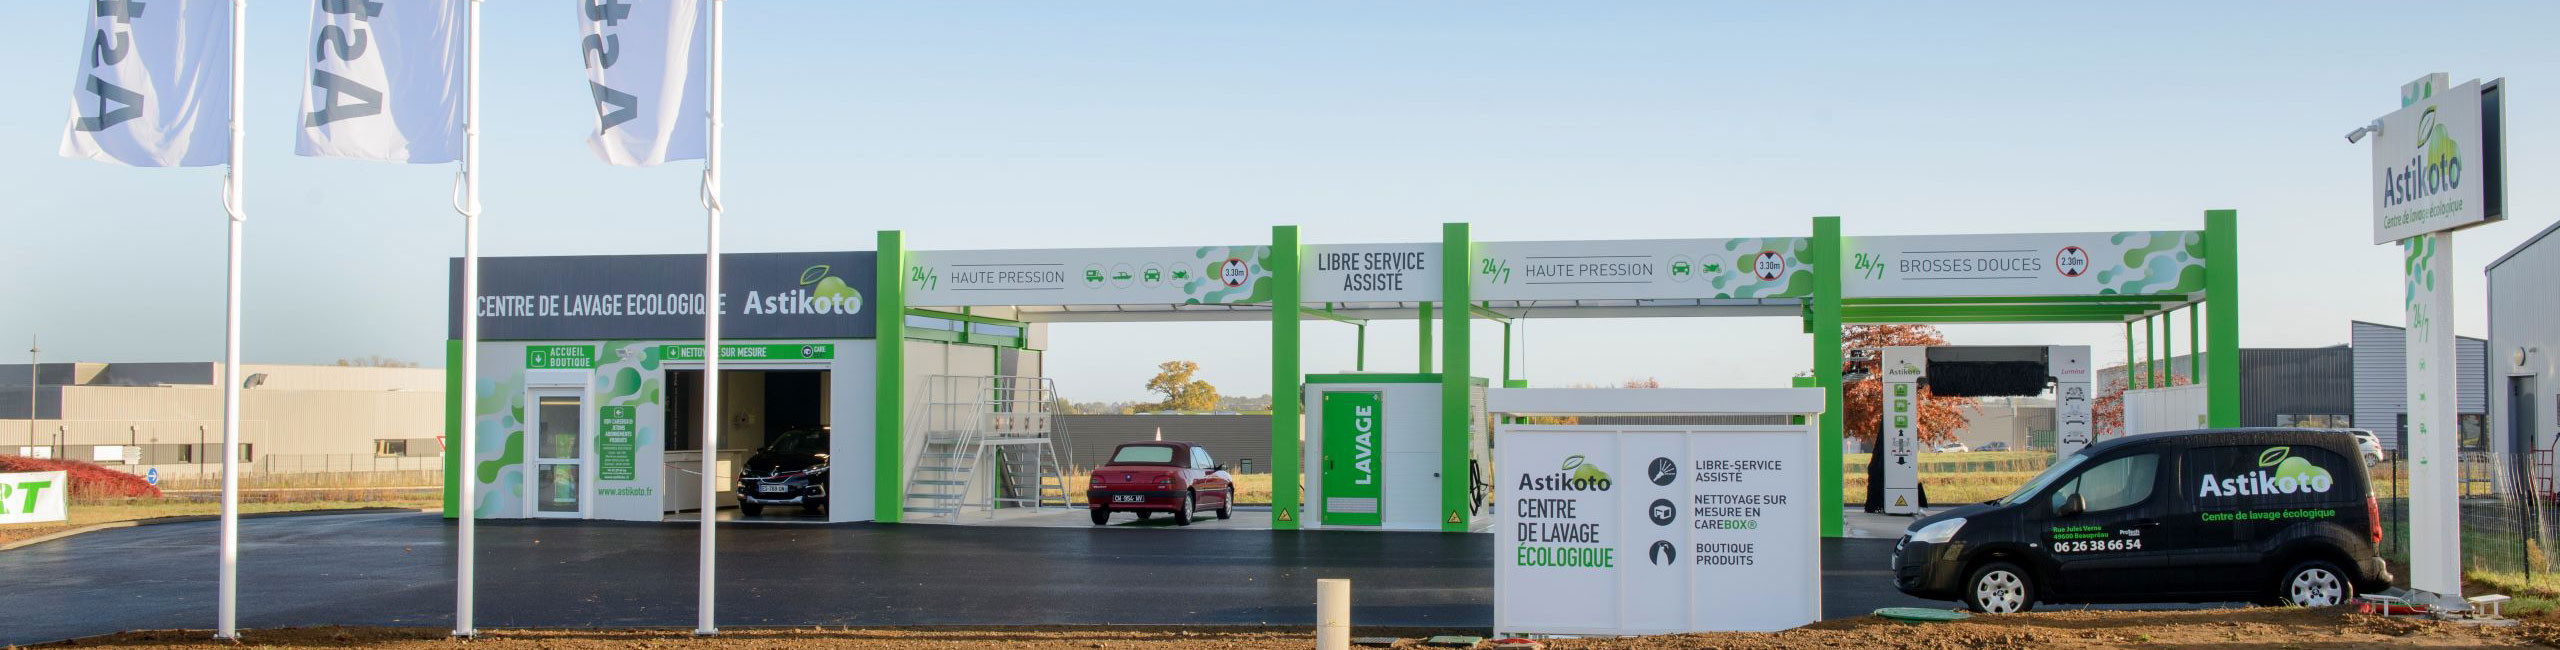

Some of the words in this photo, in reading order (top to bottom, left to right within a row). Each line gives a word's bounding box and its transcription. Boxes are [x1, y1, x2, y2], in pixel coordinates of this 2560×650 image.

[2384, 153, 2461, 208] Astikoto
[2384, 215, 2401, 230] Centre
[1318, 253, 1360, 271] LIBRE
[1364, 252, 1425, 270] SERVICE
[1760, 261, 1780, 270] 3.30m
[1854, 253, 1885, 280] 24/7
[1900, 259, 1972, 273] BROSSES
[1978, 258, 2042, 272] DOUCES
[2061, 257, 2084, 266] 2.30m
[951, 272, 995, 284] HAUTE
[999, 271, 1065, 283] PRESSION
[1225, 269, 1245, 277] 3.30m
[1482, 258, 1511, 284] 24/7
[1526, 265, 1575, 277] HAUTE
[1579, 264, 1653, 276] PRESSION
[911, 266, 938, 291] 24/7
[1343, 269, 1403, 291] ASSISTÉ
[477, 295, 535, 317] CENTRE
[539, 295, 560, 317] DE
[563, 294, 623, 316] LAVAGE
[627, 293, 727, 316] ECOLOGIQE
[743, 289, 861, 315] Astikoto
[2413, 303, 2429, 343] 24/7
[551, 347, 585, 356] ACCUEIL
[721, 347, 736, 357] SUR
[738, 346, 767, 357] MESURE
[551, 357, 591, 367] BOUTIQUE
[1889, 368, 1921, 376] Astikoto
[1355, 405, 1372, 485] LAVAGE
[1695, 460, 1782, 471] LIBRE-SERVICE
[1518, 472, 1612, 492] Astikoto
[1695, 470, 1743, 482] ASSISTÉ
[2199, 470, 2331, 498] Astikoto
[598, 486, 653, 497] www.astikoto.fr
[1694, 494, 1761, 505] NETTOYAGE
[1763, 495, 1787, 505] SUR
[1518, 498, 1577, 519] CENTRE
[1694, 507, 1742, 517] MESURE
[1745, 507, 1761, 517] EN
[2201, 512, 2234, 522] Centre
[2235, 511, 2248, 520] de
[2249, 510, 2281, 521] lavage
[2282, 508, 2336, 520] écologique
[1517, 522, 1538, 542] DE
[1542, 523, 1600, 543] LAVAGE
[1696, 543, 1754, 554] BOUTIQUE
[2054, 541, 2070, 552] 06
[2072, 541, 2088, 552] 26
[2090, 540, 2106, 551] 38
[2107, 540, 2124, 551] 66
[2125, 539, 2141, 550] 54
[1517, 542, 1614, 568] ÉCOLOGIQUE
[1696, 555, 1754, 566] PRODUITS
